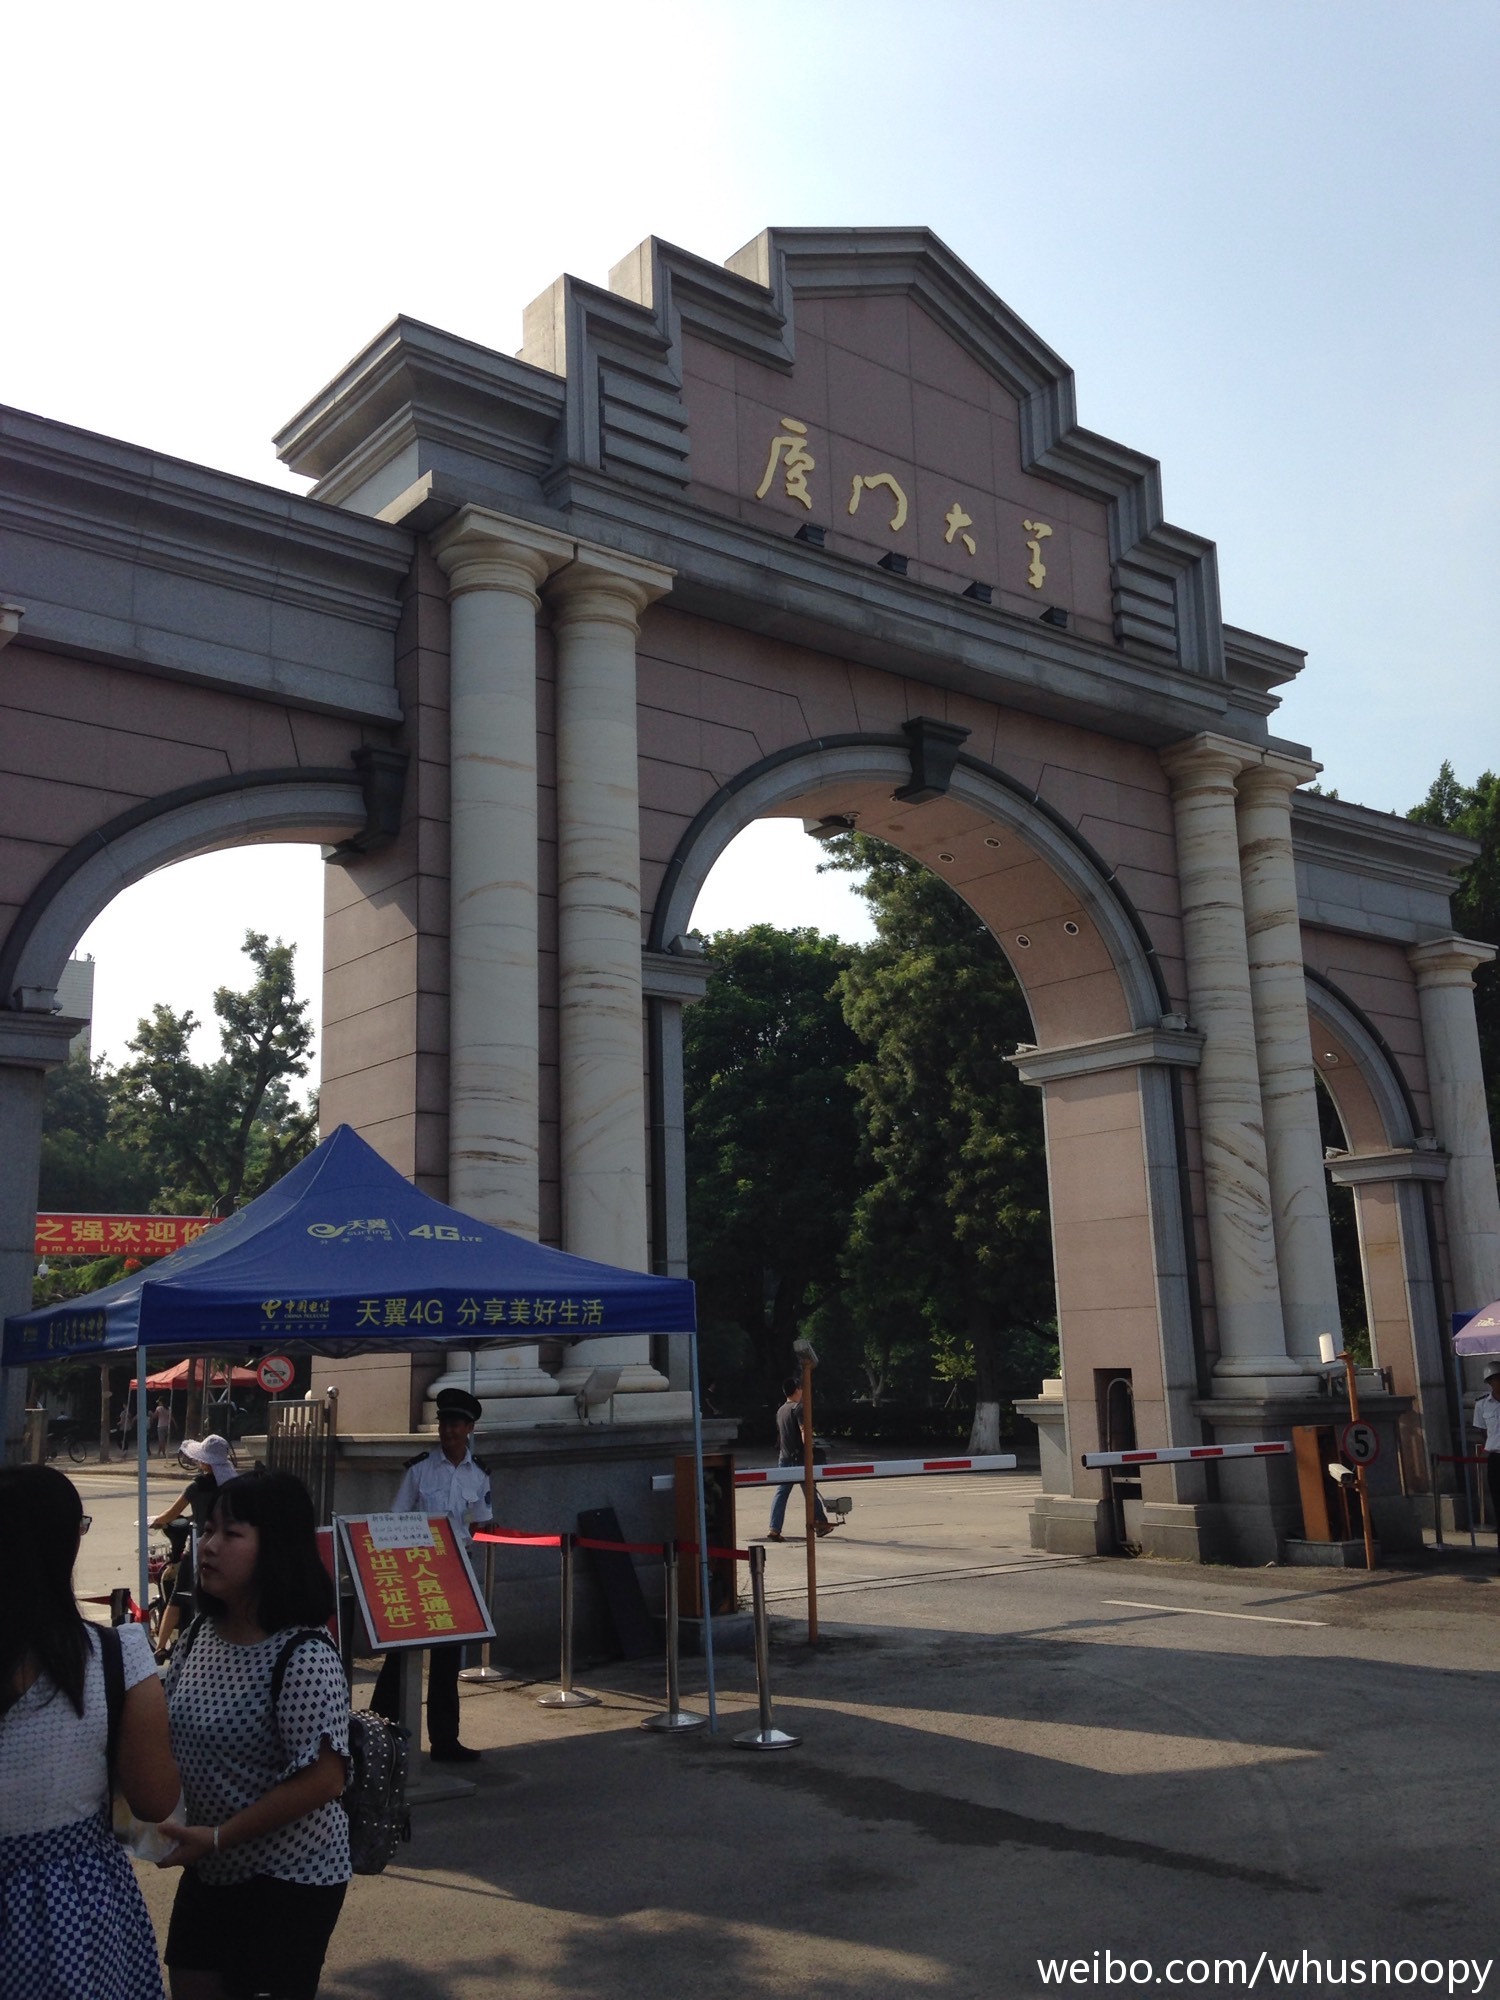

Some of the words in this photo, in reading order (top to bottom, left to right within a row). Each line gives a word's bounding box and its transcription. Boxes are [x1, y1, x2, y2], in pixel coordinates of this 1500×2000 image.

[347, 1219, 389, 1230] 天翼
[408, 1224, 460, 1241] 4G
[284, 1299, 330, 1314] 中国电信
[355, 1298, 443, 1327] 天翼4G
[456, 1298, 604, 1326] 分享美好生活
[1354, 1430, 1369, 1457] 5
